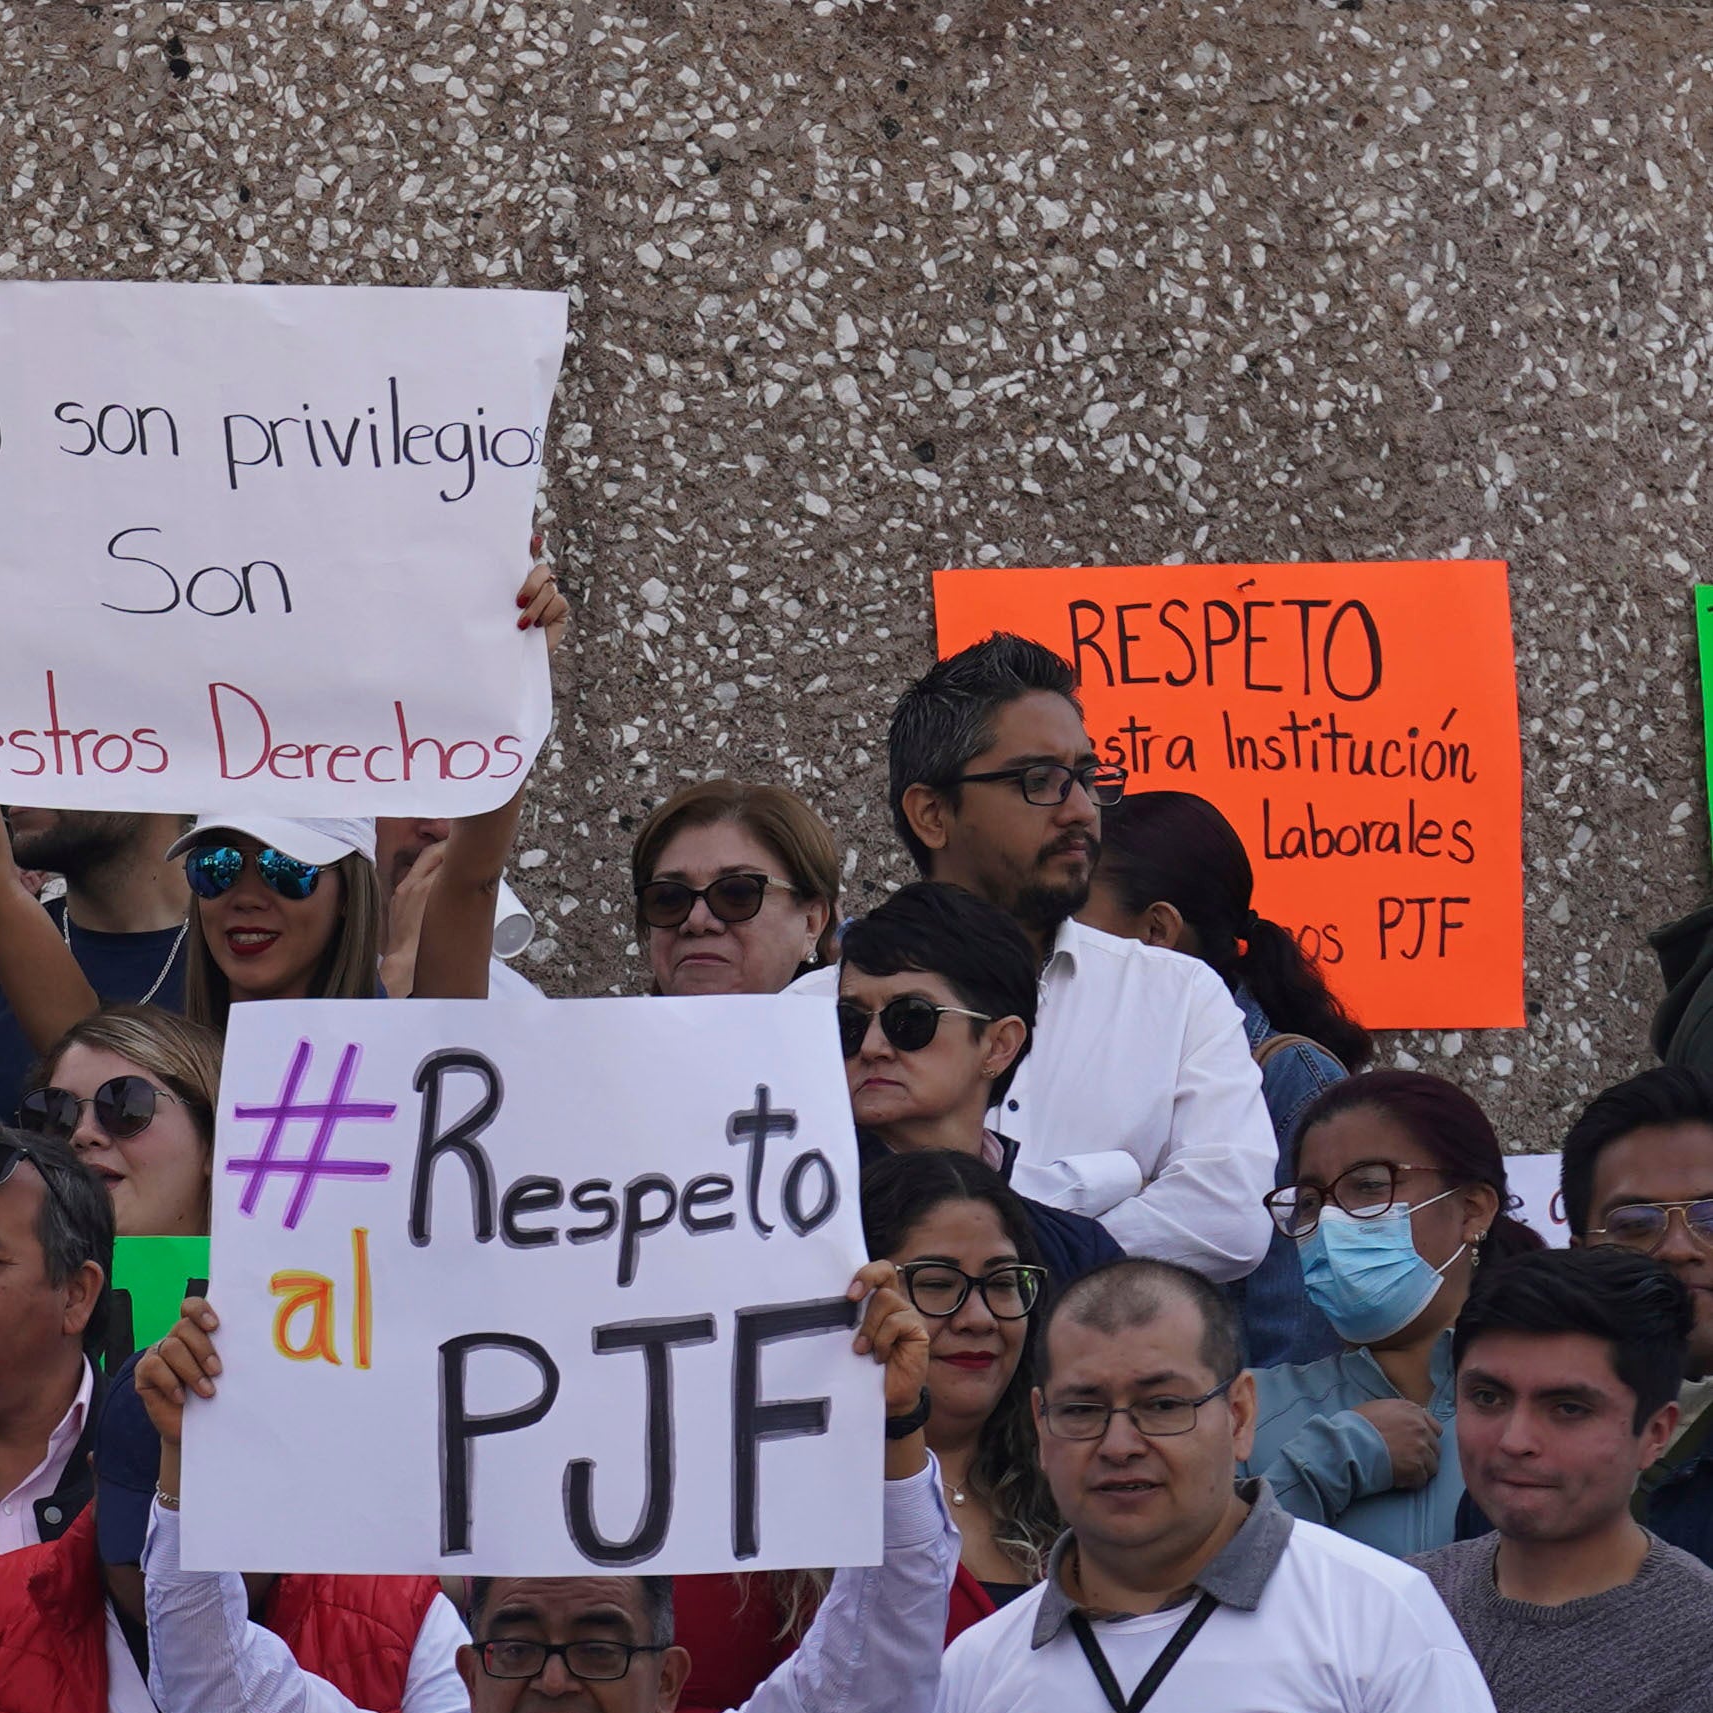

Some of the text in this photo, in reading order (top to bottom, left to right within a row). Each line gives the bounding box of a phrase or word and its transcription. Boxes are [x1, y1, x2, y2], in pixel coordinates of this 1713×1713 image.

[55, 401, 179, 456] son
[224, 377, 544, 503] privilegios
[101, 527, 292, 616] Son
[210, 682, 522, 783] Derechos
[1091, 708, 1476, 784] stra Institución
[1263, 799, 1474, 864] Laborales
[1377, 896, 1469, 960] PJF
[226, 1037, 841, 1288] #Respeto
[270, 1228, 372, 1370] al
[438, 1298, 862, 1567] PJF
